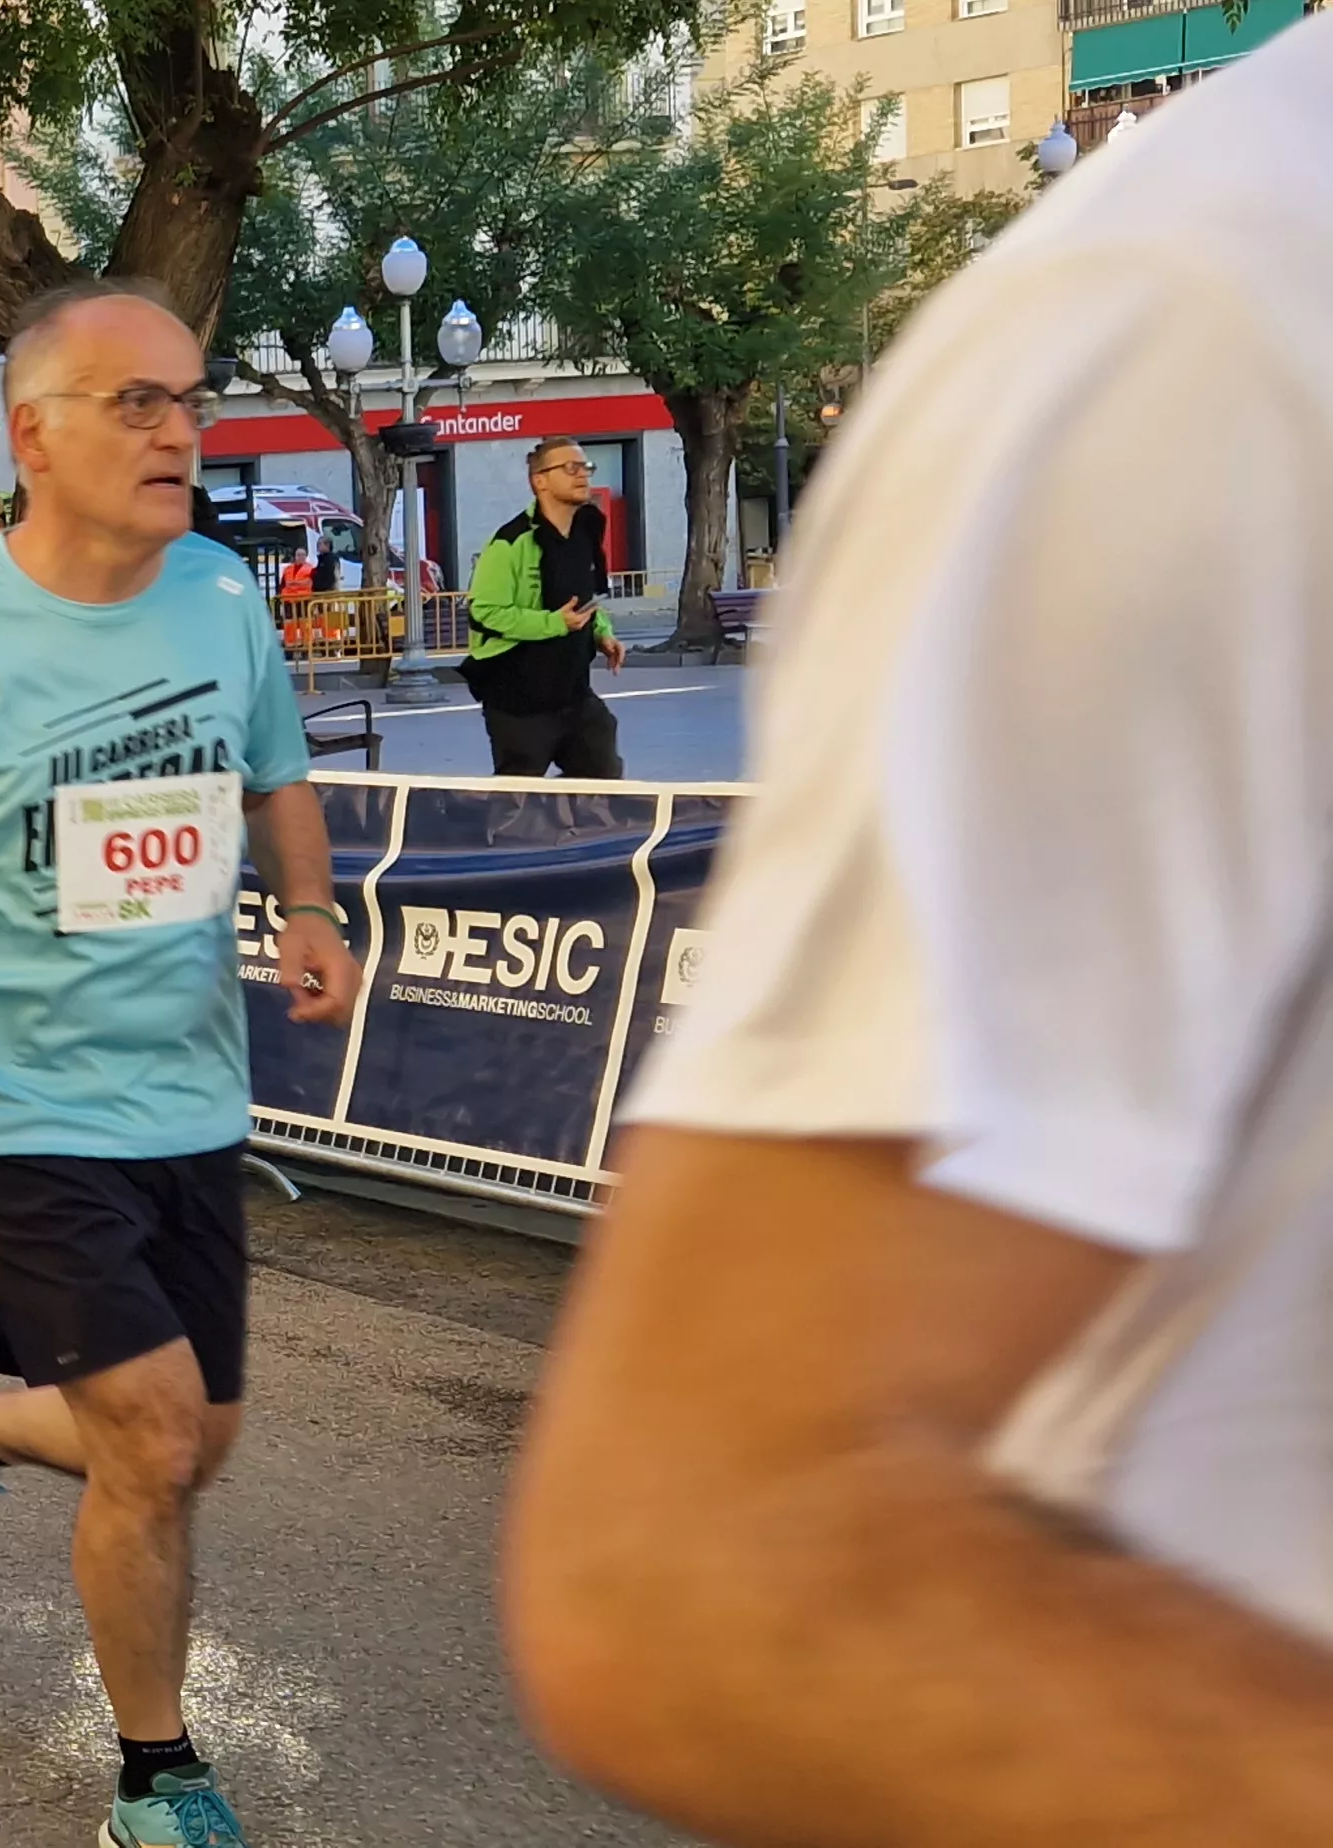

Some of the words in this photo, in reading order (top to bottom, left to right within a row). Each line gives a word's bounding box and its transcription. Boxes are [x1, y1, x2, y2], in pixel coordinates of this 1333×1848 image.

[103, 824, 203, 873] 600
[124, 874, 185, 896] PEPE
[447, 909, 605, 996] ESIC
[389, 983, 593, 1026] BUSINESS&MARKETINGSCHOOL
